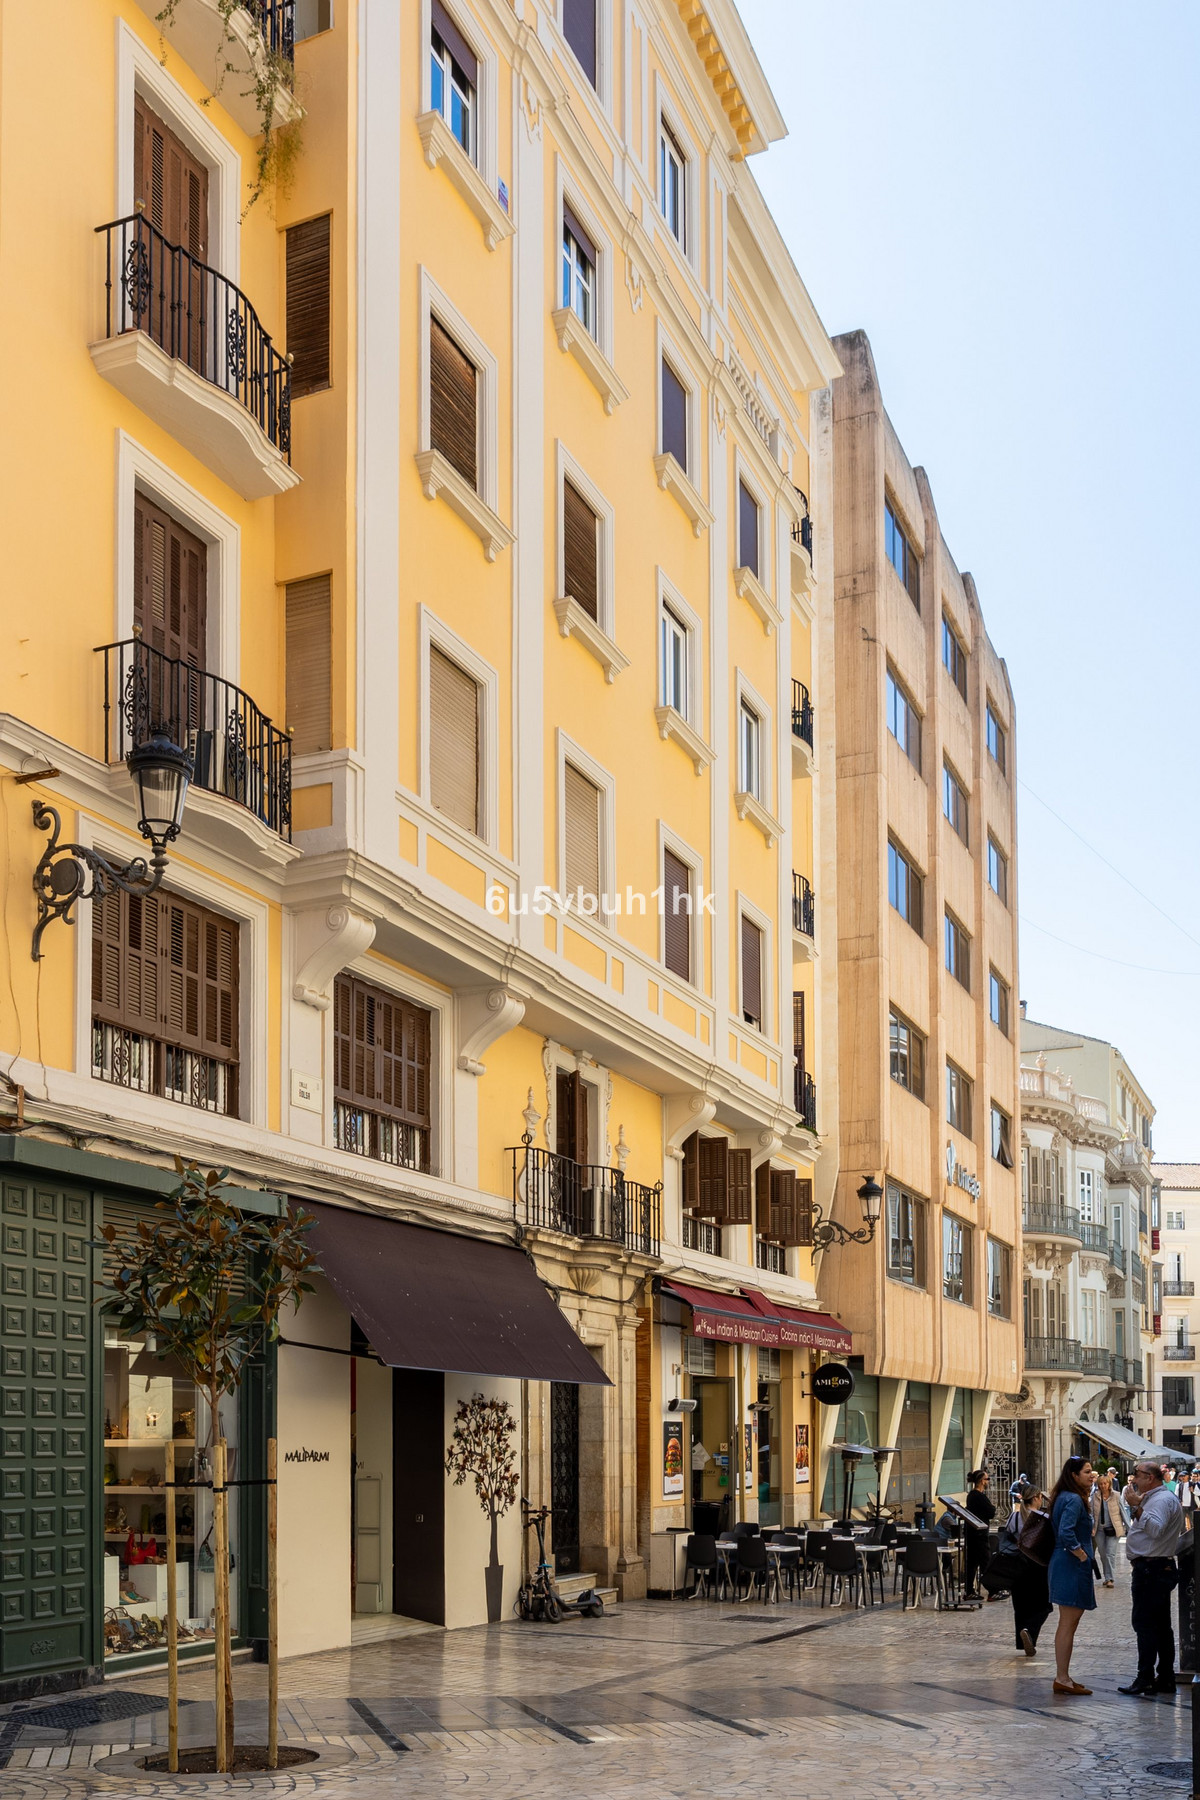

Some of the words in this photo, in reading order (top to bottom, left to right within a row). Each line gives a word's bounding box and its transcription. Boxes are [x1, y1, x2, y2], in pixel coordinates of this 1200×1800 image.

[299, 1089, 310, 1100] BOLSA
[716, 1322, 733, 1337] Indian
[739, 1325, 760, 1341] Mexican
[780, 1327, 798, 1342] Cocina
[814, 1334, 836, 1348] Mexicana
